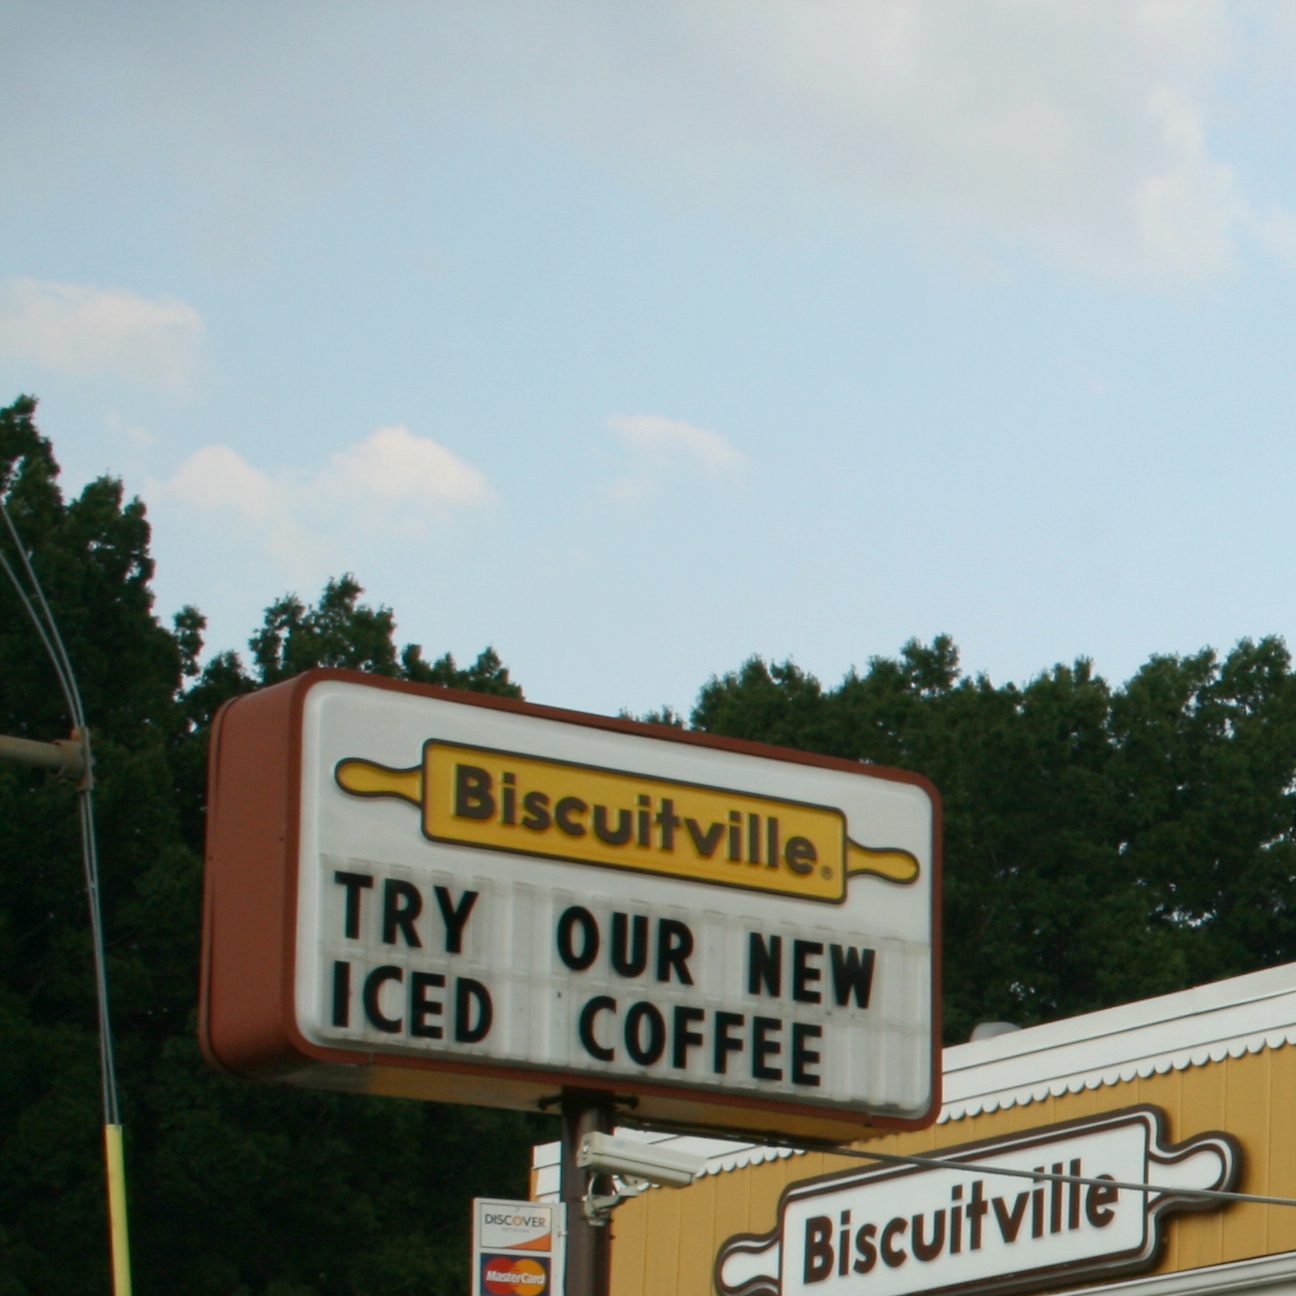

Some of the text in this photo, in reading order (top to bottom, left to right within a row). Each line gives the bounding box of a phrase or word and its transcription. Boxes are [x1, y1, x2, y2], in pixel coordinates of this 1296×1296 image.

[452, 763, 819, 877] Biscuitville
[334, 870, 875, 1009] TRY OUR NEW
[333, 961, 823, 1087] ICED COFFEE
[485, 1214, 546, 1228] DISCOVER
[486, 1270, 546, 1285] MasterCard
[803, 1158, 1118, 1285] Biscuitville
